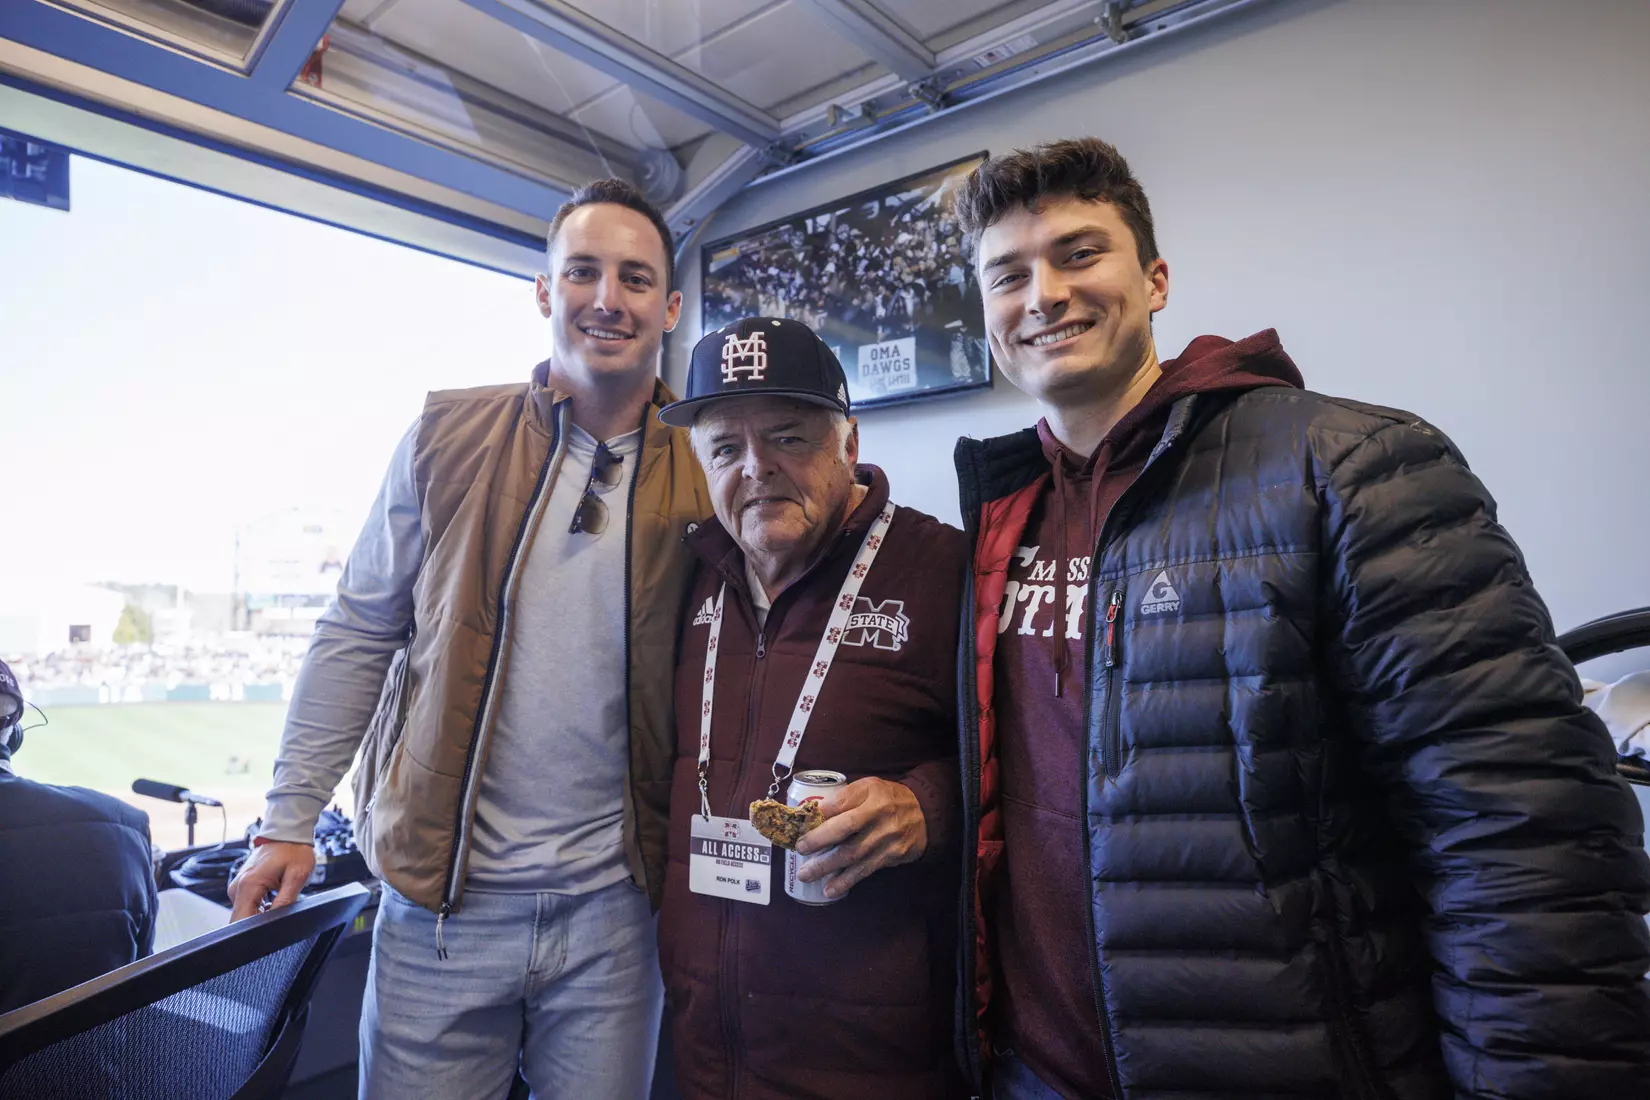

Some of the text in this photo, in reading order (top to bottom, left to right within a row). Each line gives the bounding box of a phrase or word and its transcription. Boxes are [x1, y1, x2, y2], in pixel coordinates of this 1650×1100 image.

[870, 344, 901, 360] OMA
[862, 358, 911, 376] DAWGS
[1027, 556, 1090, 582] MSS.
[1140, 601, 1180, 615] GERRY
[850, 614, 895, 631] STATE
[701, 840, 718, 856] ALL
[721, 843, 760, 862] ACCESS
[716, 875, 741, 885] RON POLK
